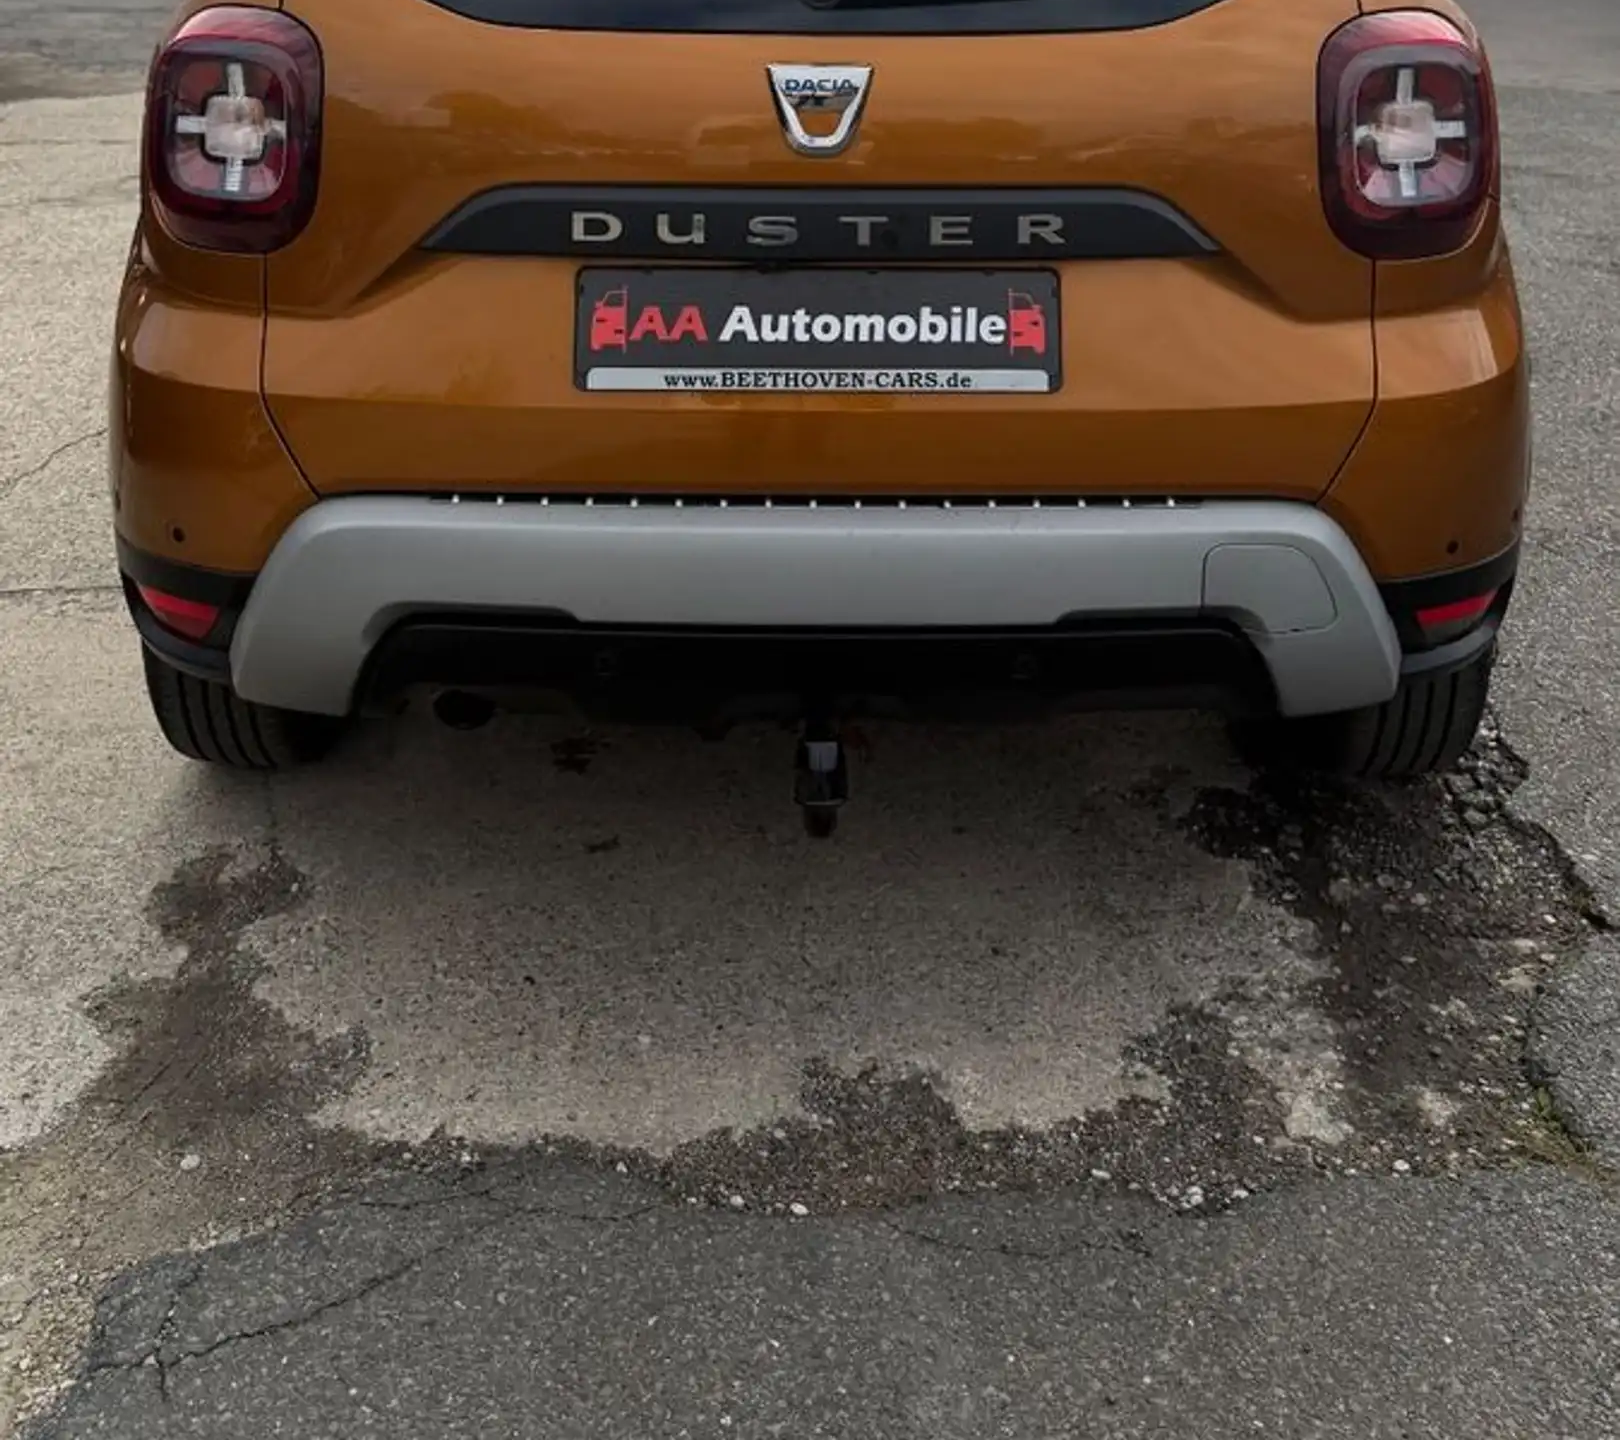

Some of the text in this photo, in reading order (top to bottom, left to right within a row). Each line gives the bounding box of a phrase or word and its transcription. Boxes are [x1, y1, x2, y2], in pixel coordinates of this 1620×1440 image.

[784, 78, 854, 92] DACIA
[571, 211, 1067, 247] DUSTER
[629, 305, 1007, 343] AA Automobile
[664, 371, 973, 389] www.BEETHOVEN-CARS.de
